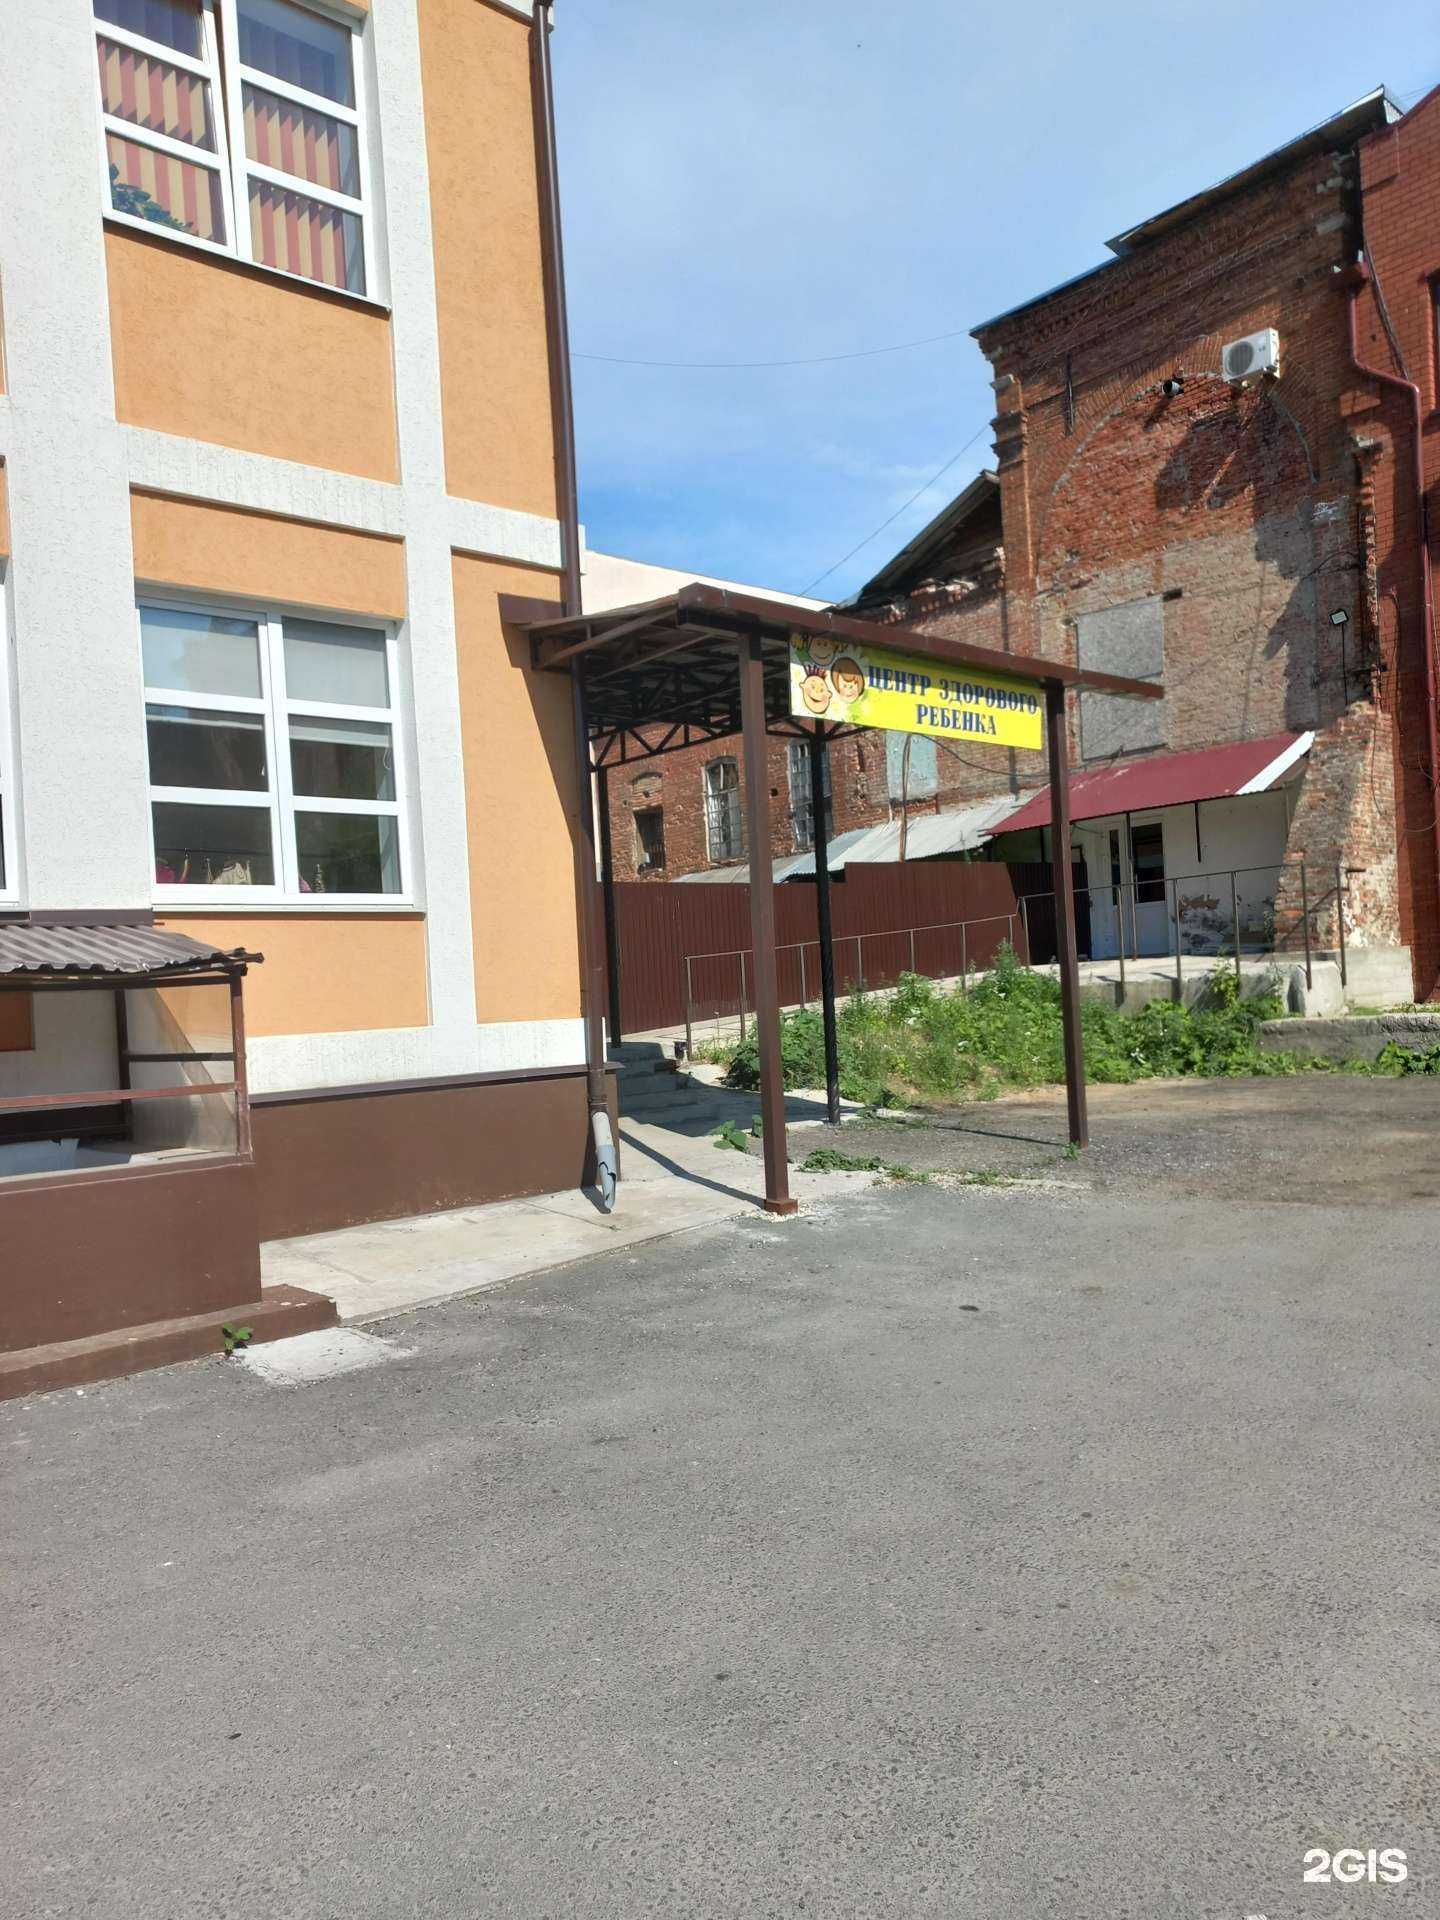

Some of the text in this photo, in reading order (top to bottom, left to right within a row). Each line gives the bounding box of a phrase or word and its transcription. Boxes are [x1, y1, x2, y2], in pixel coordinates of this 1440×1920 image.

[868, 665, 1038, 714] ЦЕНТР ЗДОРОВОГО
[916, 703, 996, 735] РЕБЕНКА
